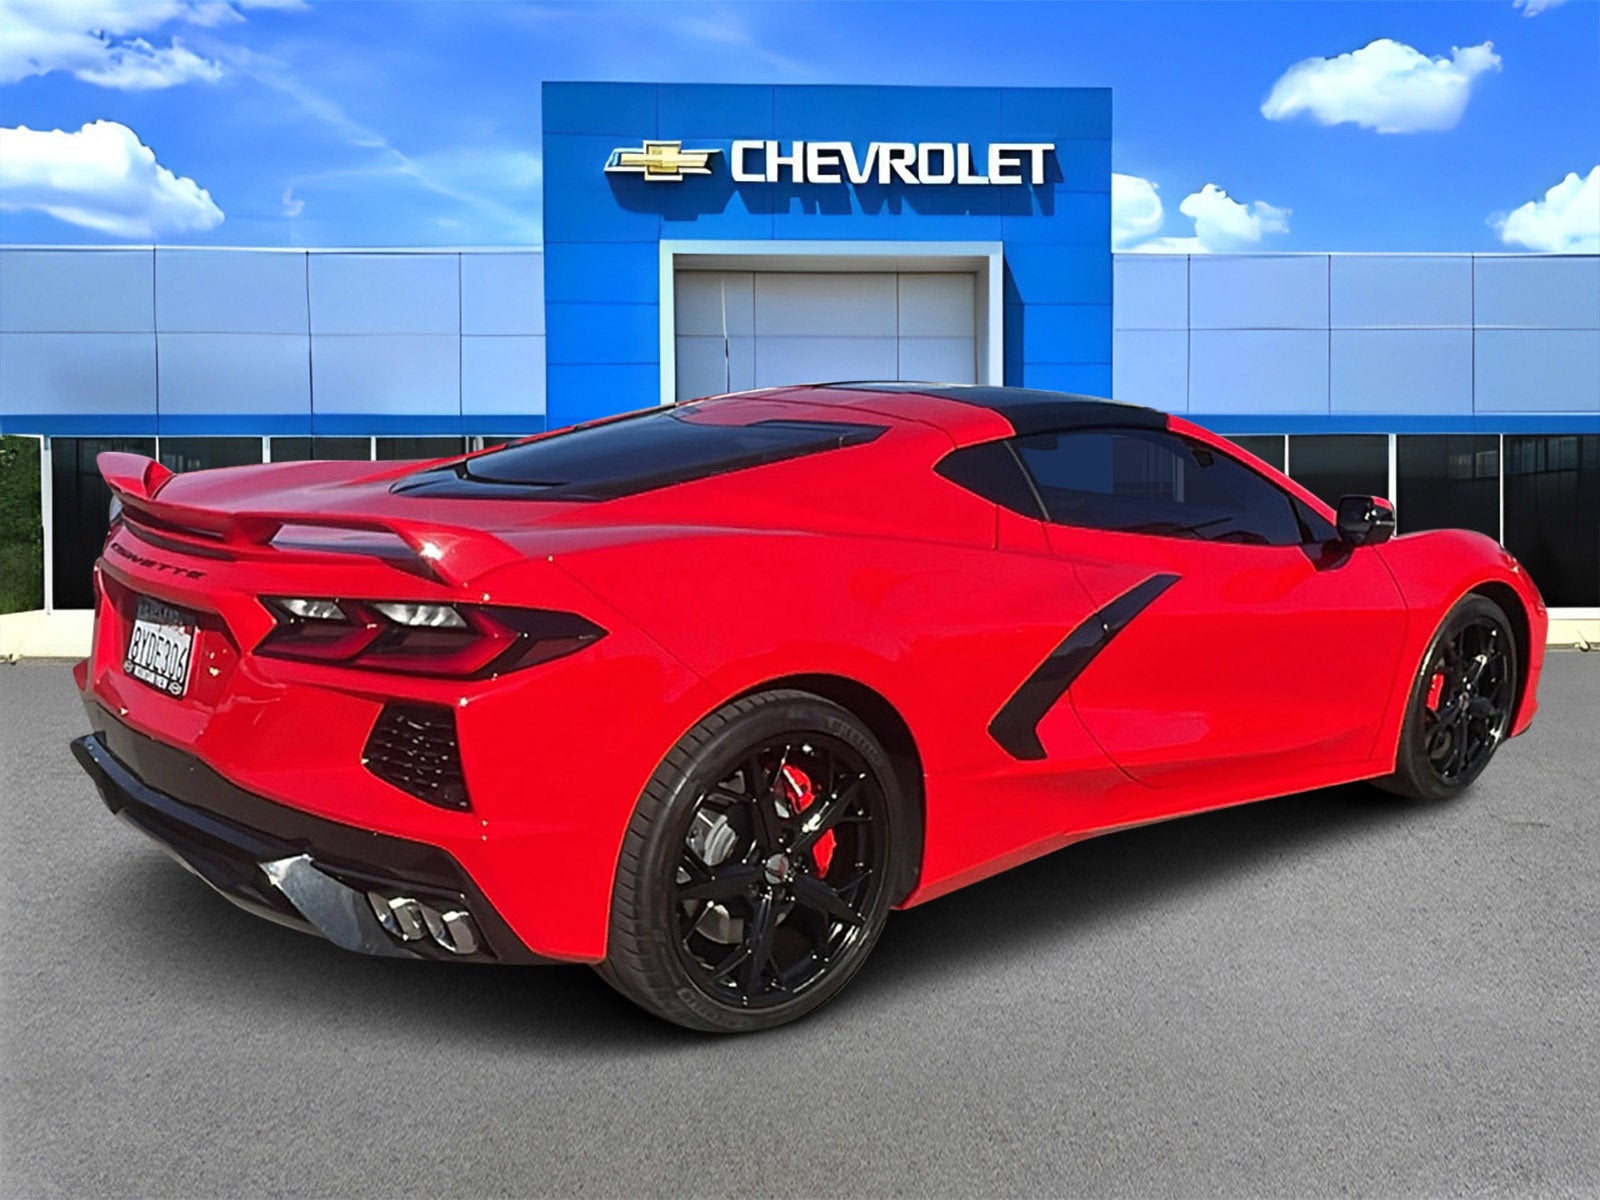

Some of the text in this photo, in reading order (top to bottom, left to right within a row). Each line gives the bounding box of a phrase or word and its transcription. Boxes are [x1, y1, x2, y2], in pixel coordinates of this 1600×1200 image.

[731, 140, 1055, 185] CHEVROLET
[110, 542, 207, 579] CORVETTE
[130, 626, 188, 683] 8YDE306
